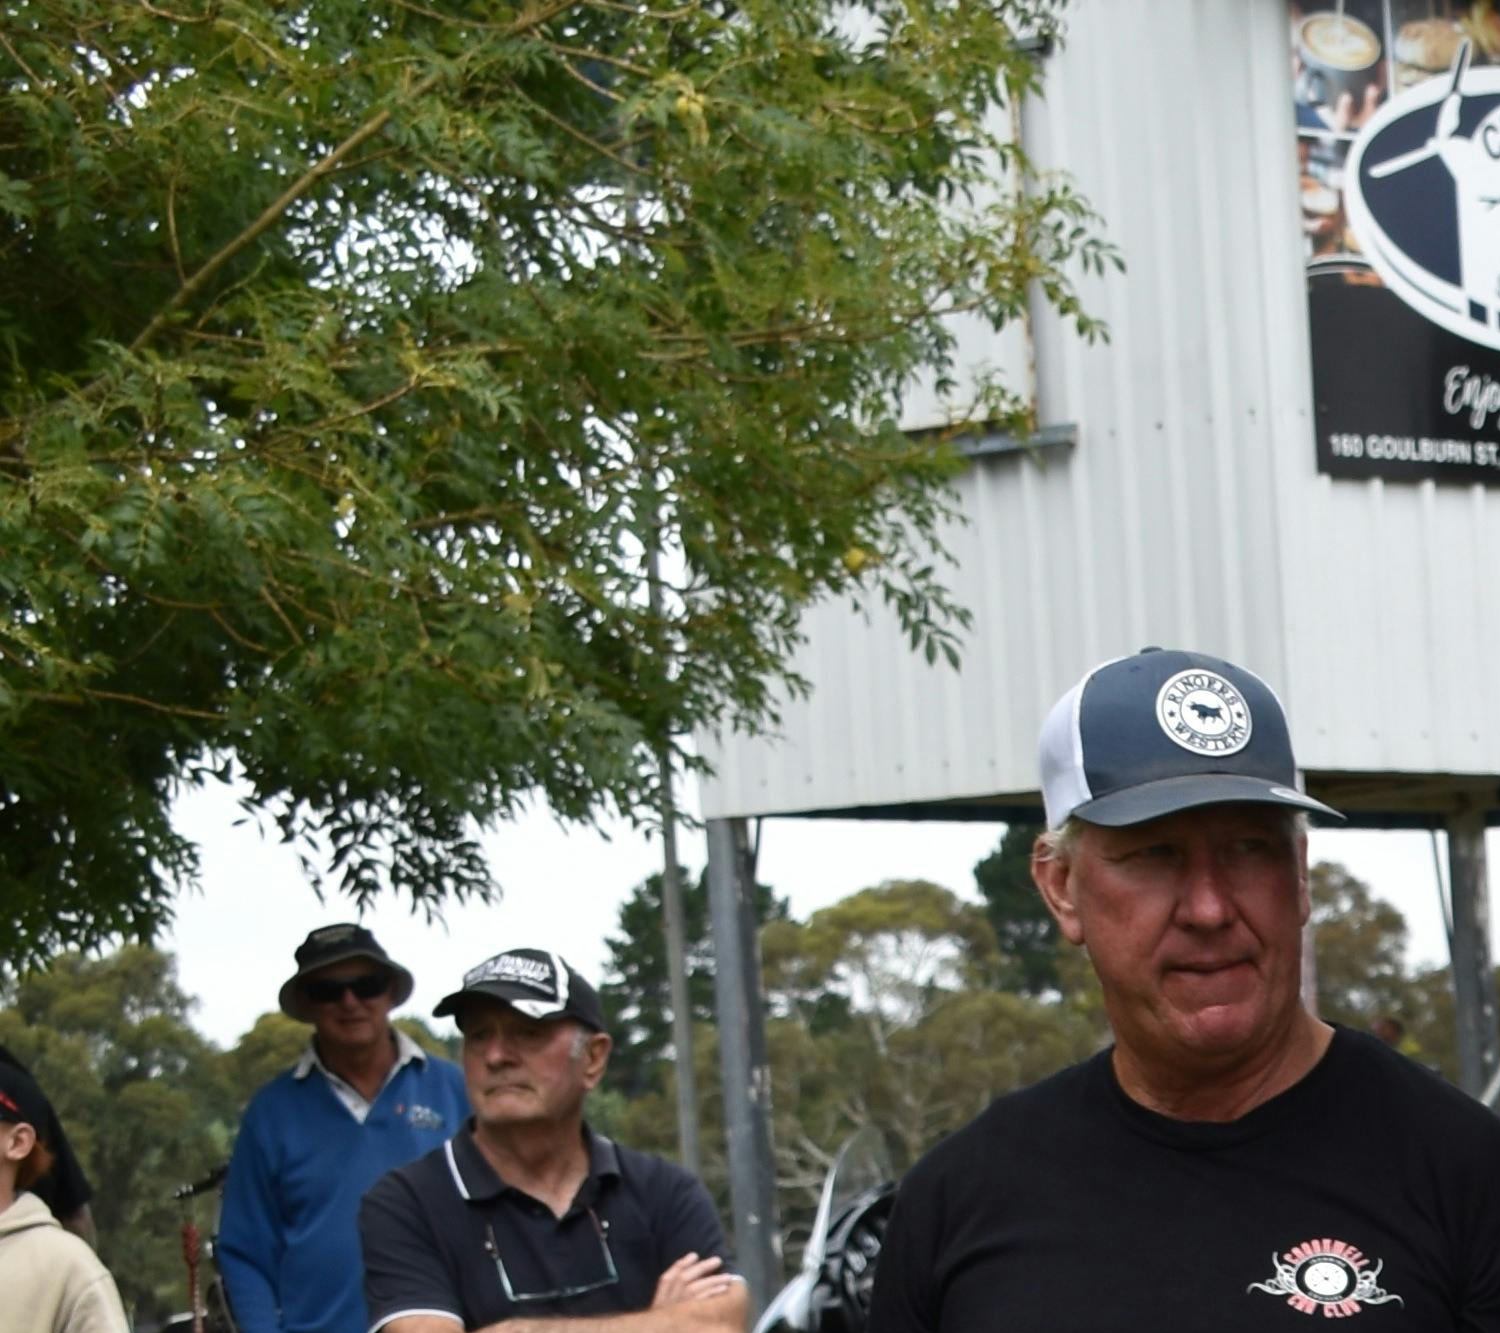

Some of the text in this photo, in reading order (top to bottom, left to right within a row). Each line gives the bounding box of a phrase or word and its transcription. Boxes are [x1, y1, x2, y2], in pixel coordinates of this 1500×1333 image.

[1366, 435, 1472, 464] GOULBURN
[1168, 674, 1240, 705] RINGERS
[1176, 722, 1245, 750] WESTERN
